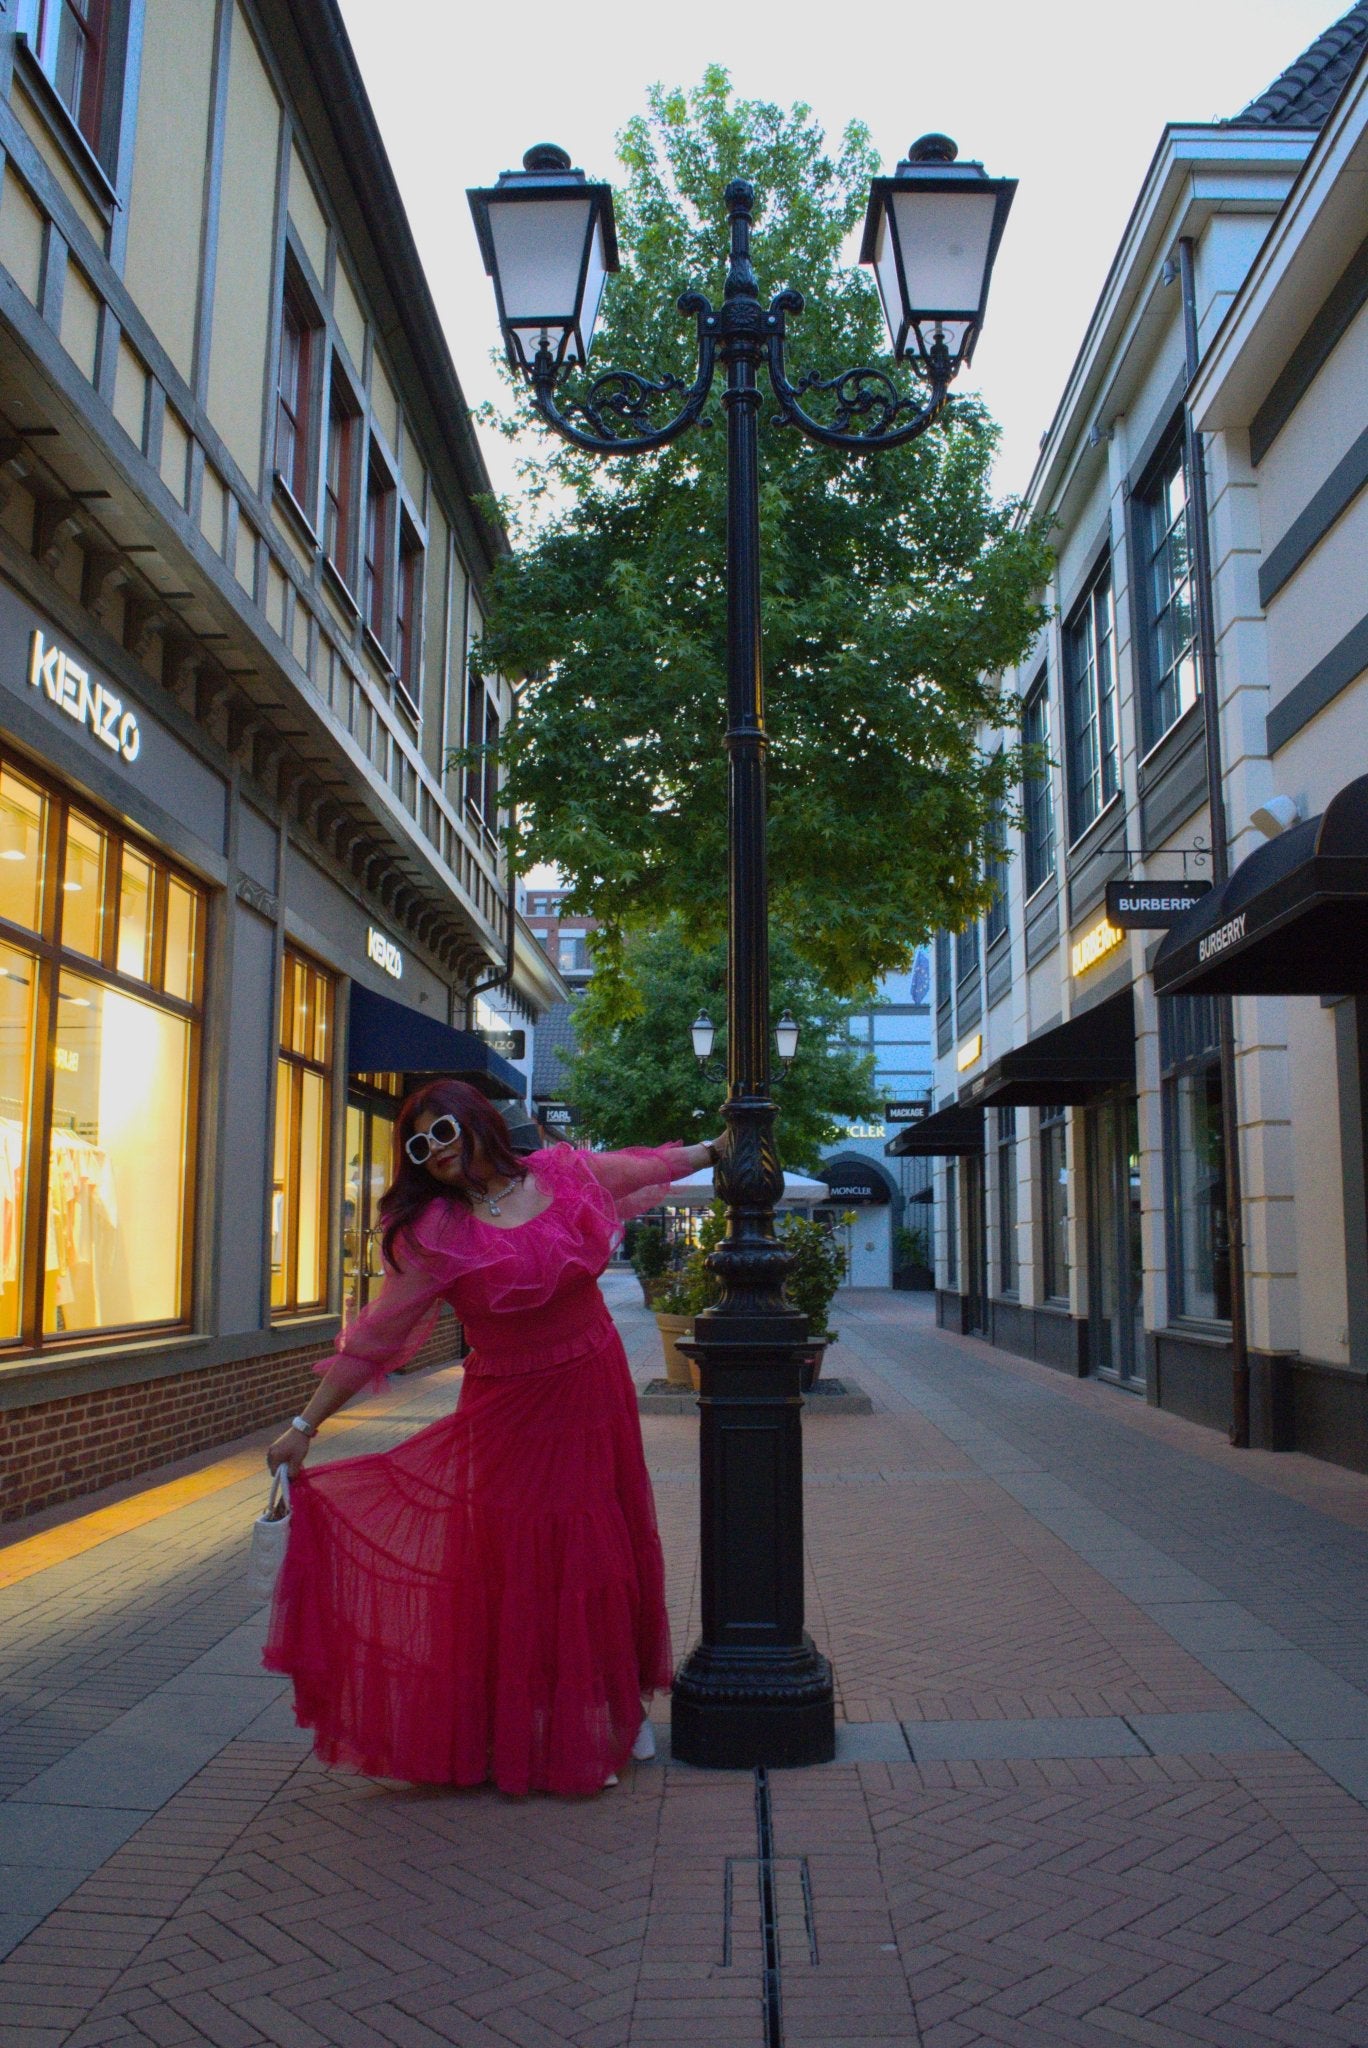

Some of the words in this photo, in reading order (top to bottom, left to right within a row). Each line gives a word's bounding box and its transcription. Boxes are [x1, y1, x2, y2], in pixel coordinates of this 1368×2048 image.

[29, 630, 140, 764] KENZO
[1199, 912, 1247, 962] BURBERRY
[367, 926, 402, 980] KENZO
[546, 1110, 571, 1119] KARL
[890, 1108, 924, 1118] MACKAGE
[831, 1186, 872, 1195] MONCLER
